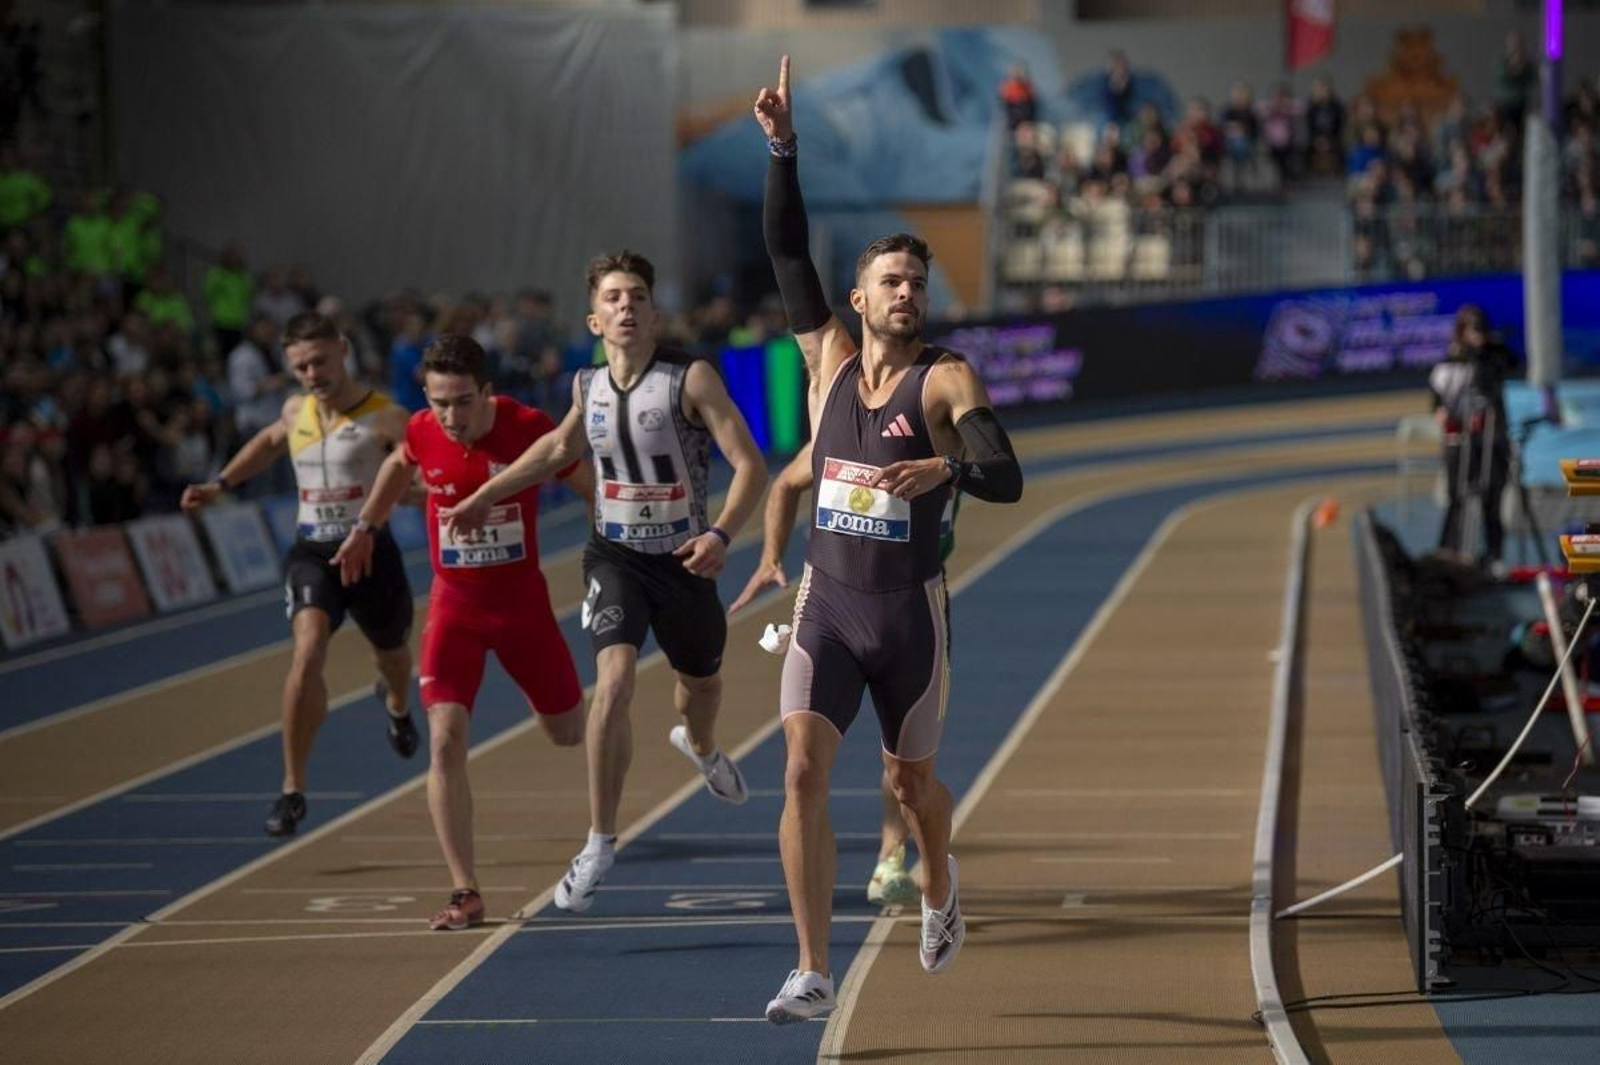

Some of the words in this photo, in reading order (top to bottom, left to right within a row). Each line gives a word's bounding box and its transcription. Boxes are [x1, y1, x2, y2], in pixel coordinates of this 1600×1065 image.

[639, 504, 652, 519] 4
[620, 523, 675, 540] Joma
[828, 511, 889, 535] Joma
